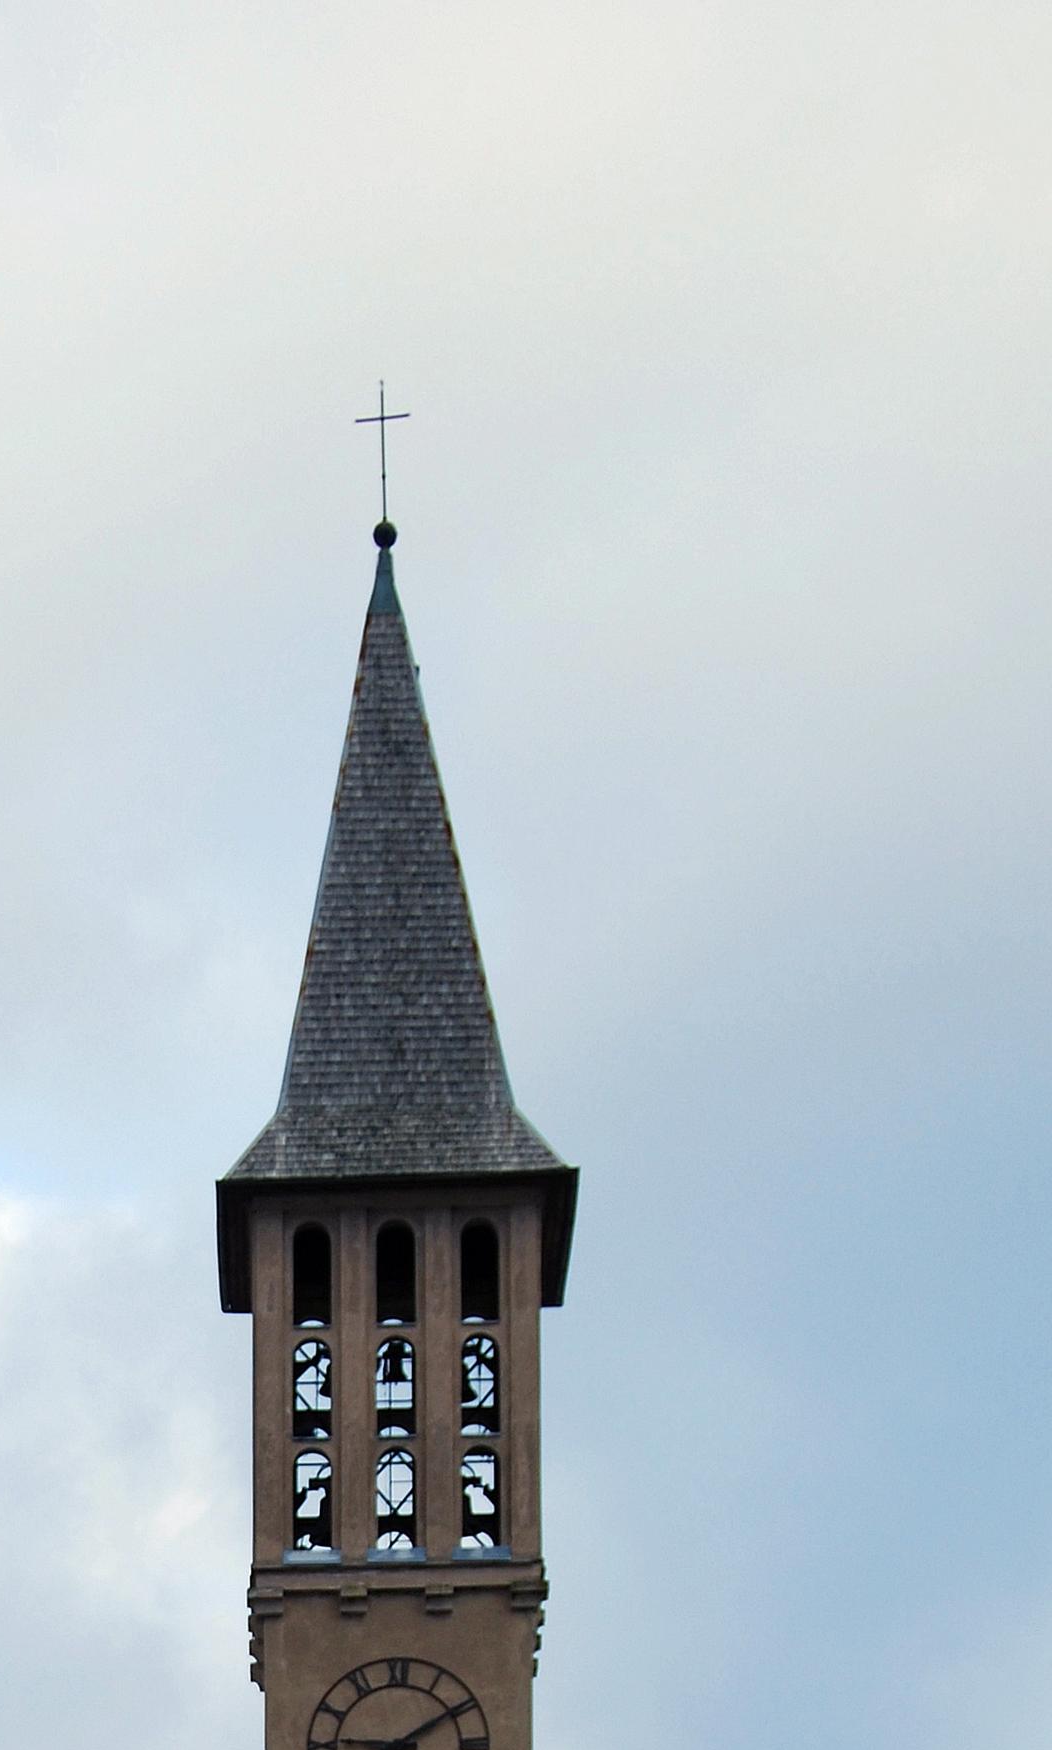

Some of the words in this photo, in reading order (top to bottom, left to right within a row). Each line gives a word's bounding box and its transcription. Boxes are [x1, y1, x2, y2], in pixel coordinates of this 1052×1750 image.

[347, 1667, 372, 1697] XI
[387, 1659, 409, 1688] XII
[317, 1700, 346, 1721] X
